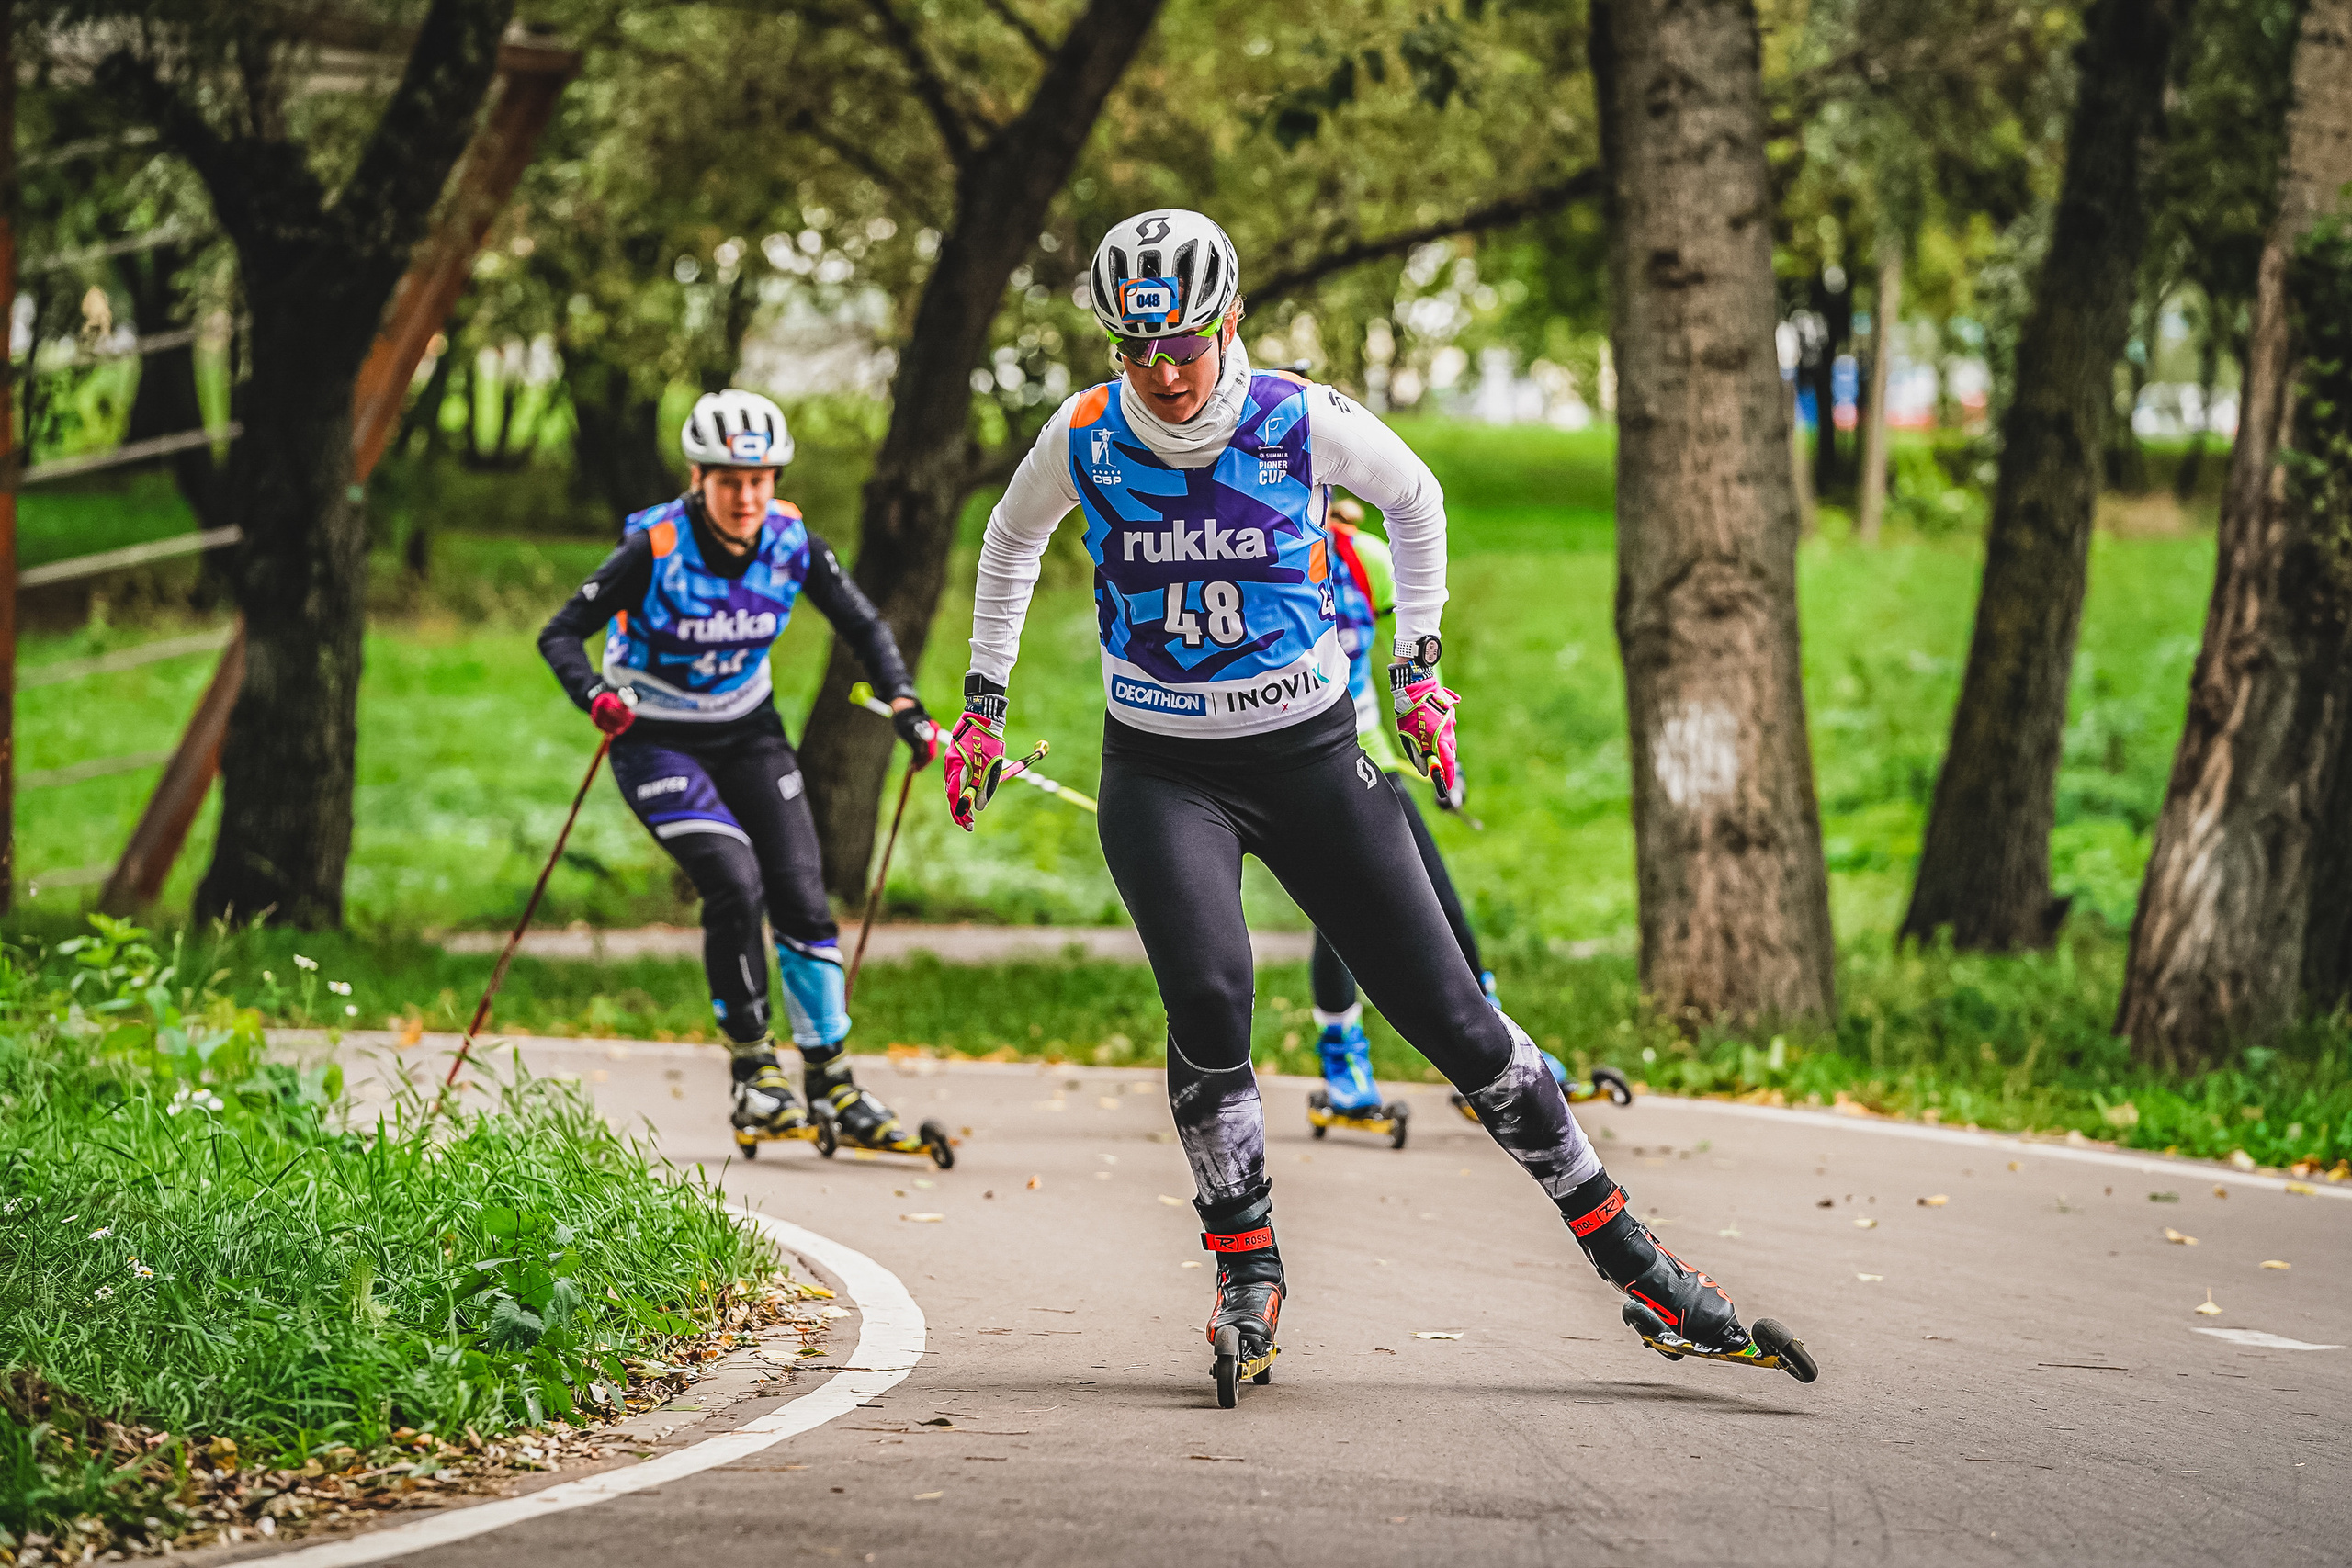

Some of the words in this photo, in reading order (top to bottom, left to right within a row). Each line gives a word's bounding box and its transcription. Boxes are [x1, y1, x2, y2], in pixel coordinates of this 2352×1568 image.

[1136, 293, 1160, 308] 048
[1259, 460, 1288, 470] PIONER
[1259, 469, 1286, 485] CUP
[1124, 519, 1268, 563] rukka
[677, 608, 777, 643] rukka
[1164, 581, 1244, 645] 48
[1115, 682, 1200, 711] DECATHLON
[1227, 662, 1330, 712] INOVIK
[1418, 711, 1429, 746] LEKI
[973, 736, 982, 780] LEKI
